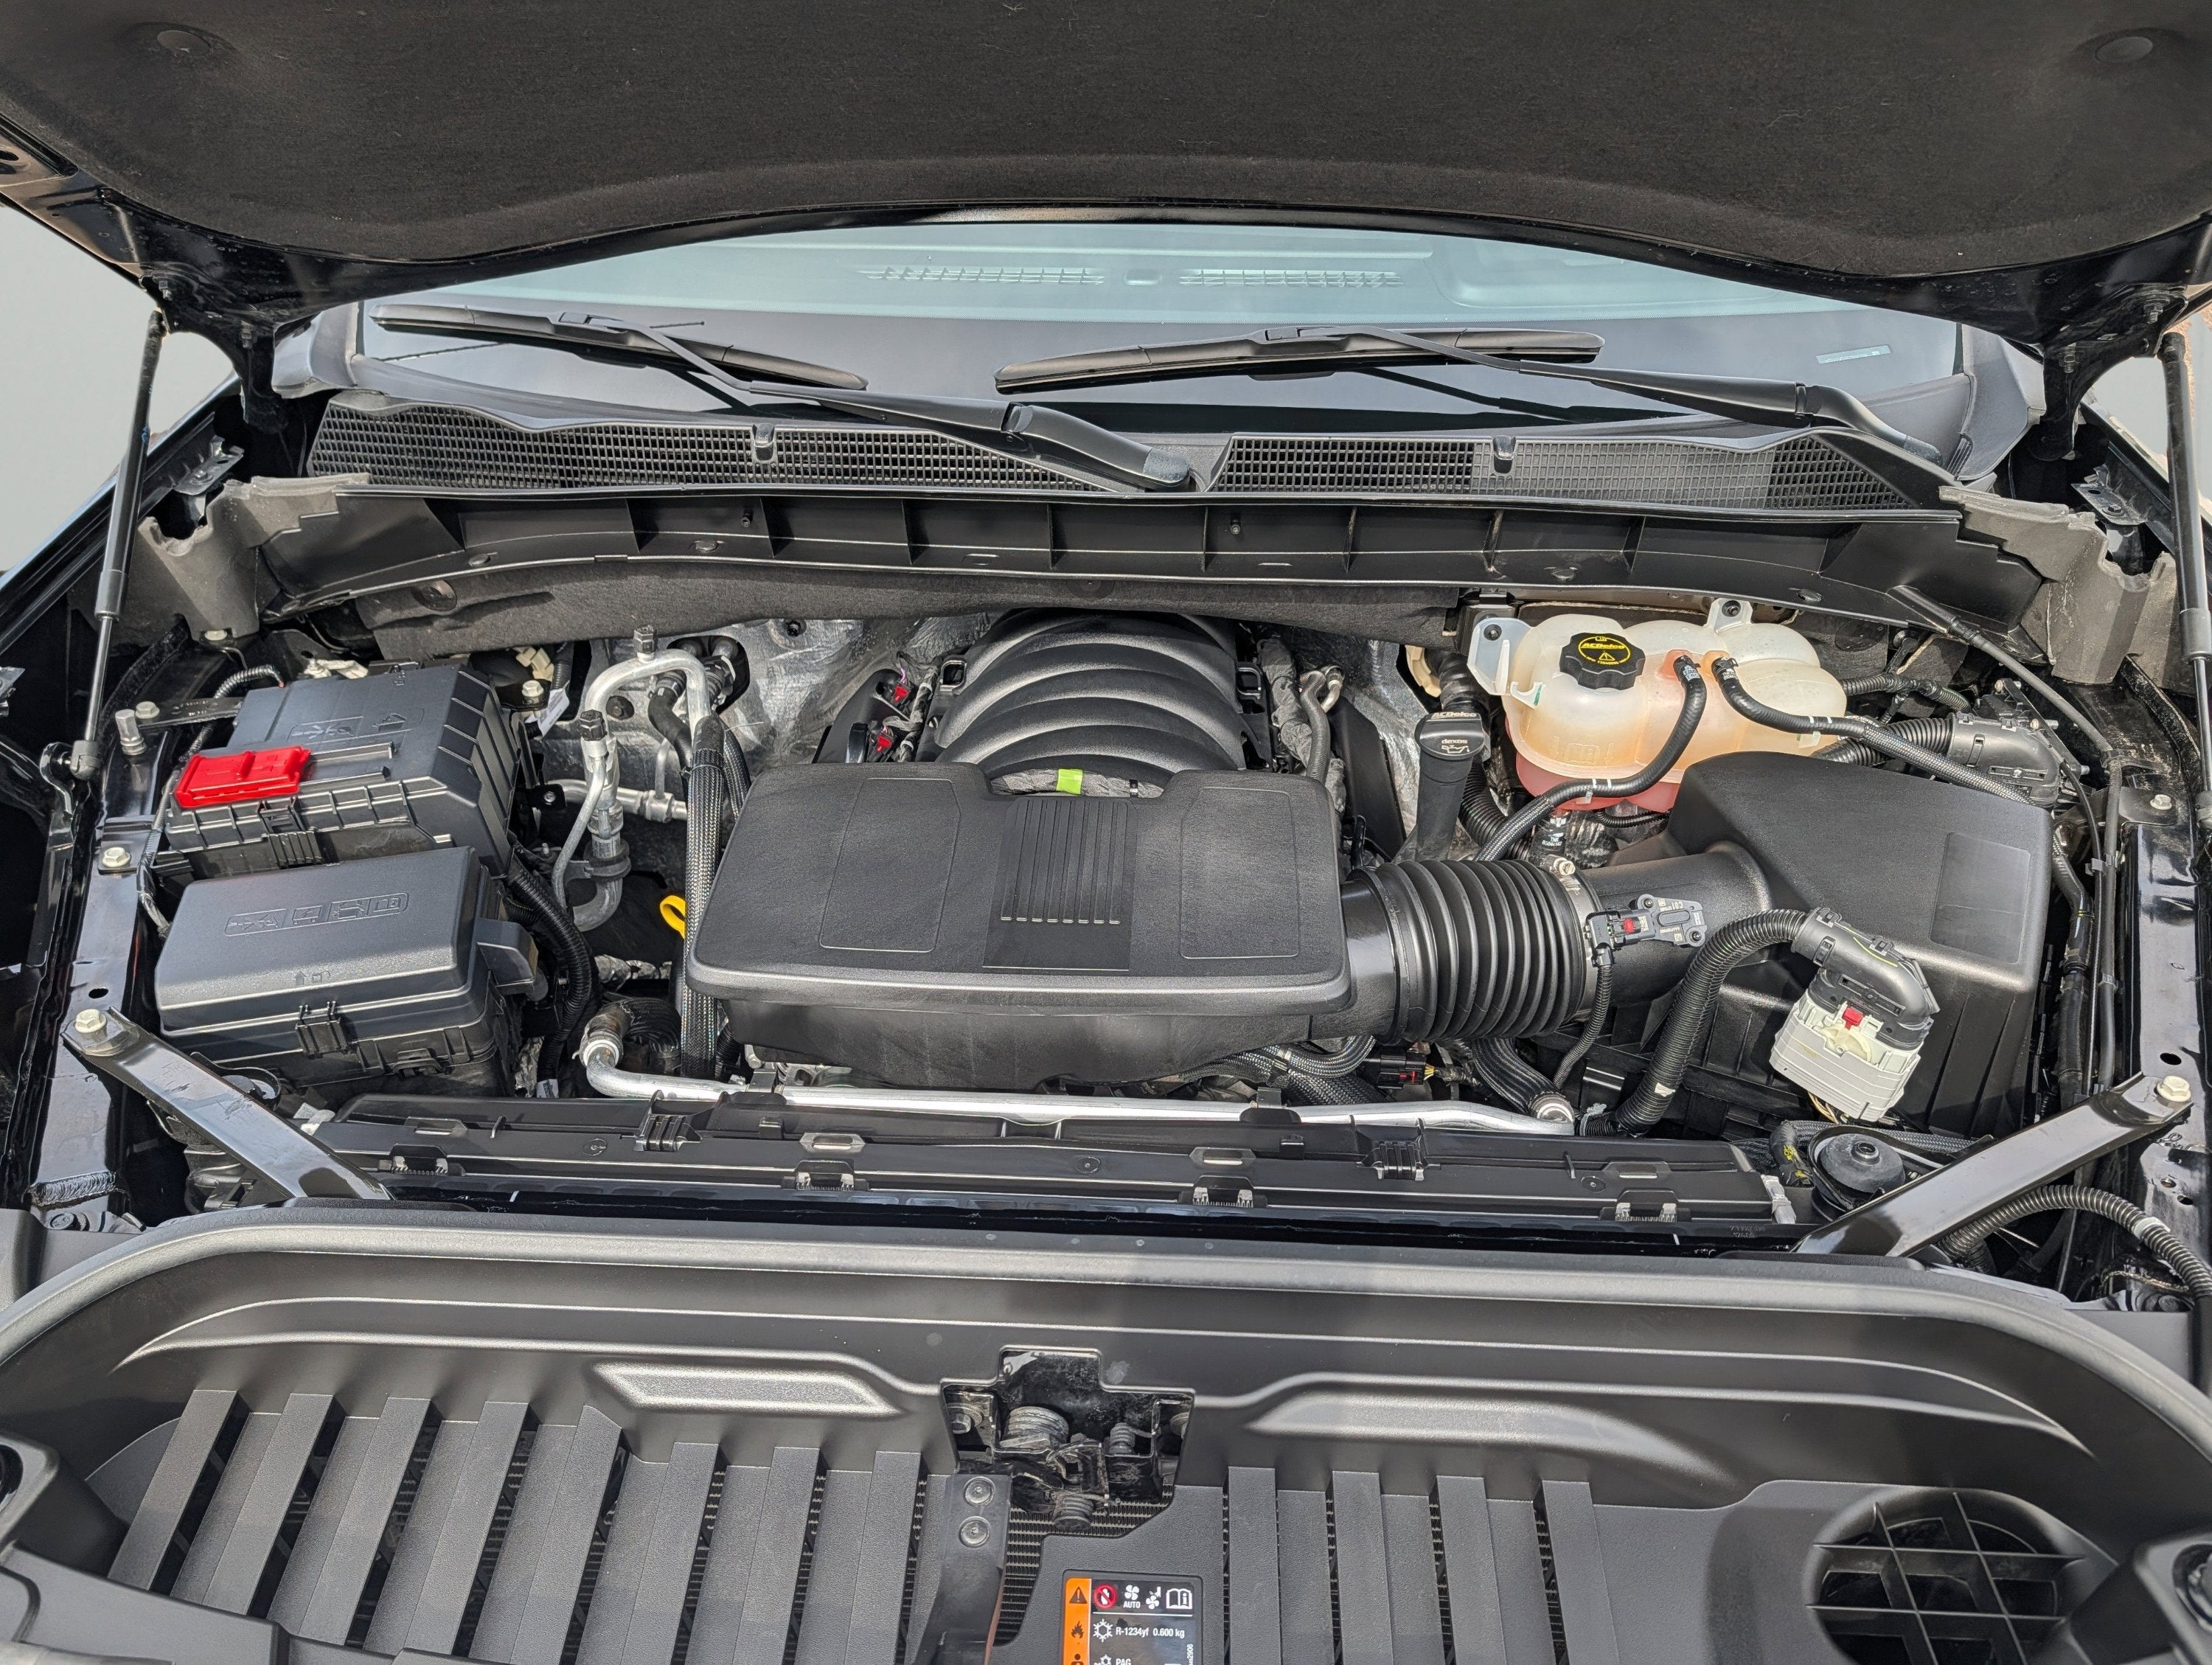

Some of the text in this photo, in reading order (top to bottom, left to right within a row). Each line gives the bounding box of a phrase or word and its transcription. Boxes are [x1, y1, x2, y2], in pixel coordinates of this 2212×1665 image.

[1123, 1601, 1141, 1609] AUTO
[1116, 1627, 1185, 1638] R-1234yf 0.600 kg
